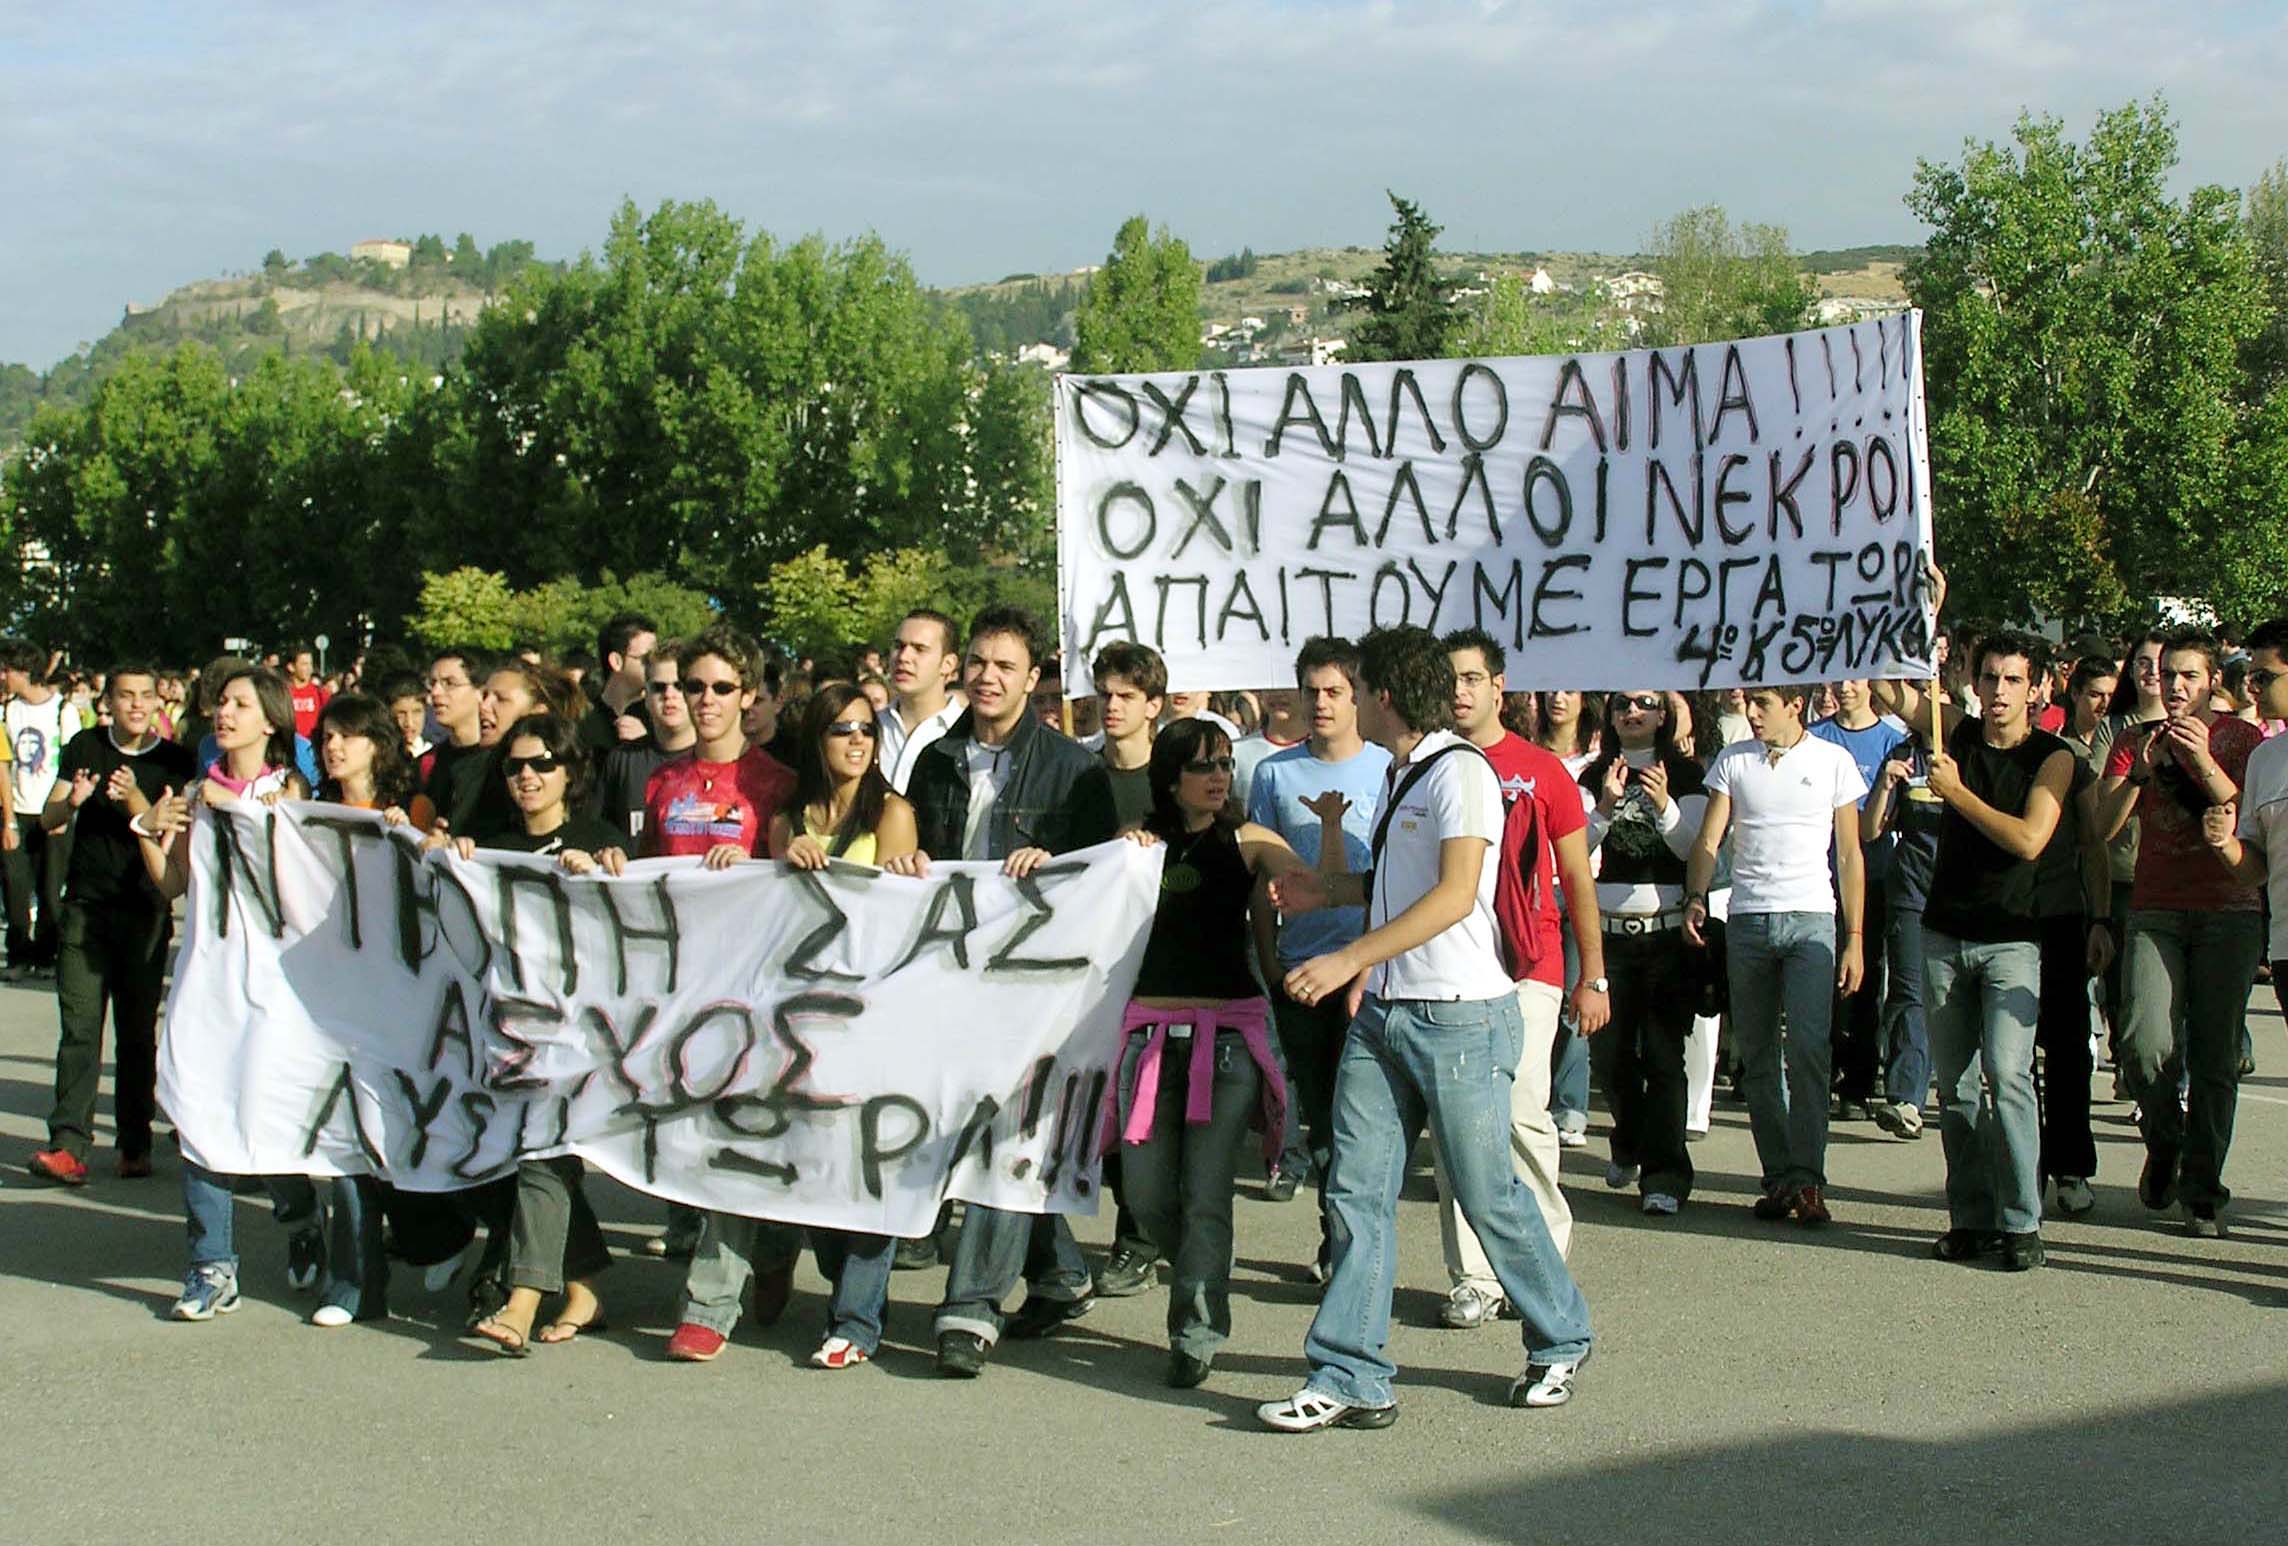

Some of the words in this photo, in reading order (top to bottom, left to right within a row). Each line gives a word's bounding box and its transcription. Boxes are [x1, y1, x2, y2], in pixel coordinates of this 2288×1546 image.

[1073, 371, 1241, 459] ΟΧΙ
[1264, 363, 1508, 462] ΑΛΛΟ
[1096, 474, 1261, 560] ΟΧΙ
[1306, 451, 1610, 549] ΑΛΛΟΙ
[1646, 428, 1914, 549] ΝΕΚΡΟΙ
[1080, 555, 1592, 657] ΑΠΑΙΤΟΥΜΕ
[1624, 554, 1786, 636] ΕΡΓΑ
[783, 860, 1091, 982] ΣΑΣ
